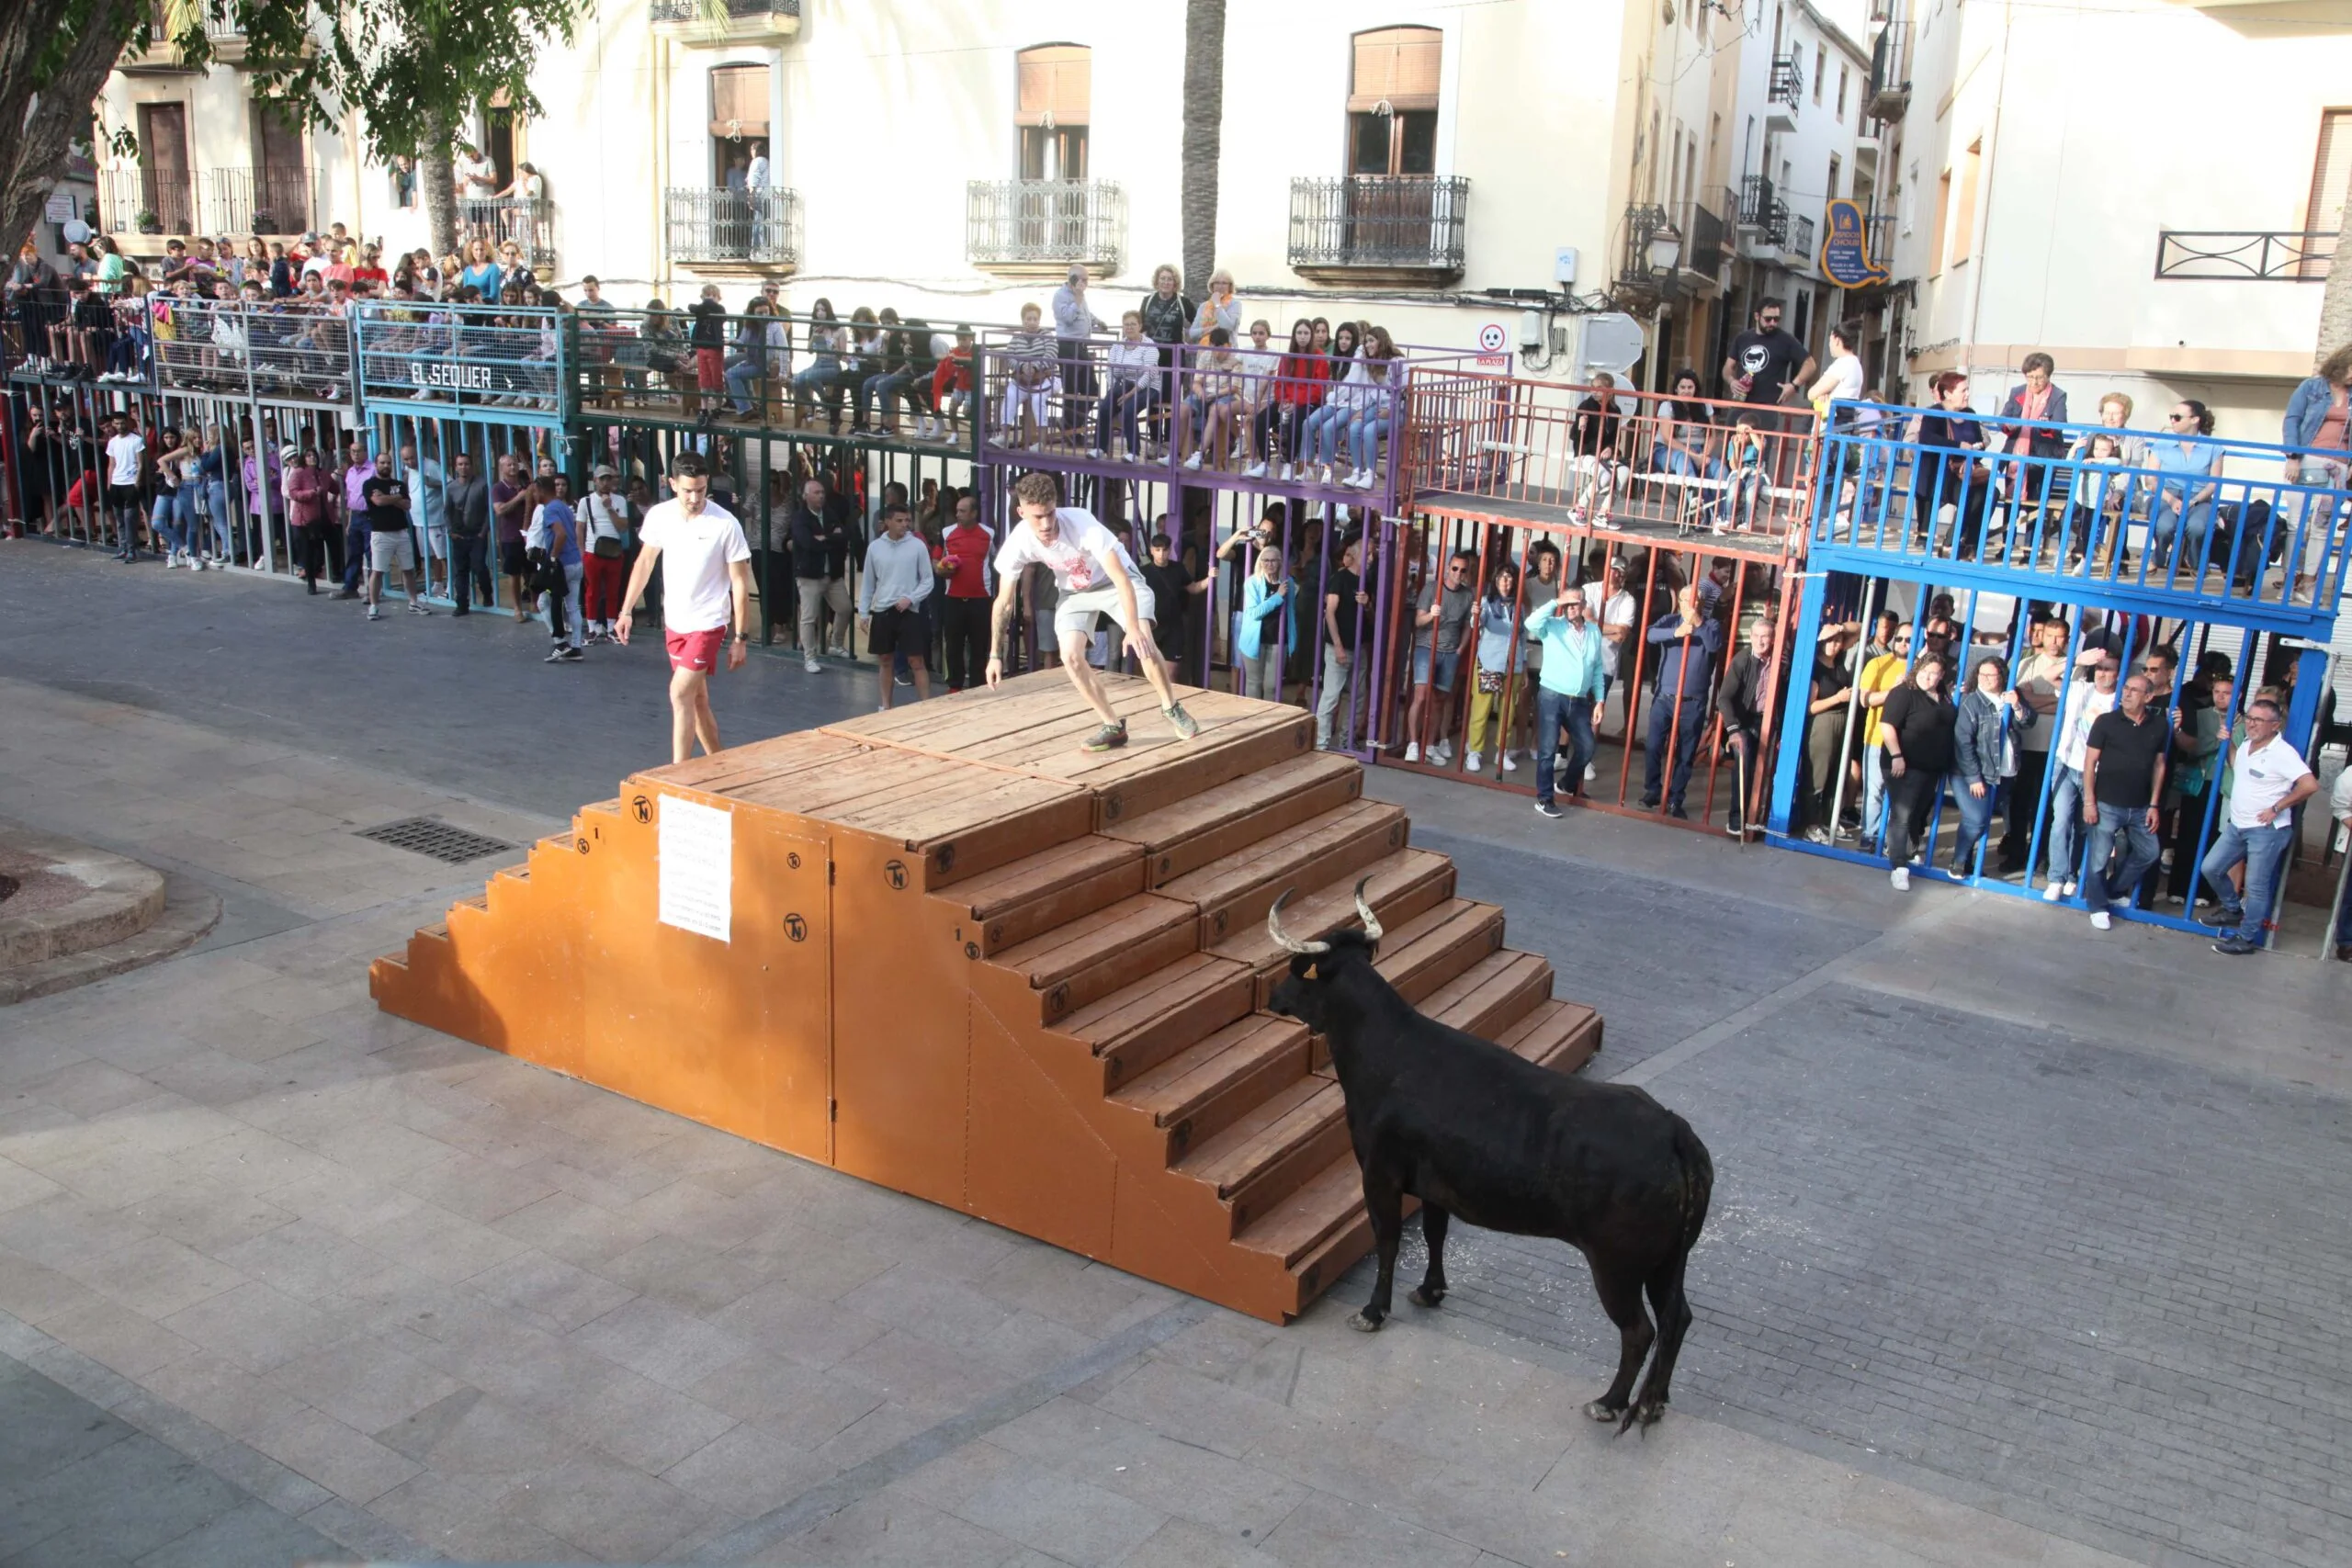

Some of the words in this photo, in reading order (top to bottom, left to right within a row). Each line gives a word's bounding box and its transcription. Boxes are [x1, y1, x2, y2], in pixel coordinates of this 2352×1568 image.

[412, 363, 427, 384] EL
[429, 364, 492, 390] SEQUER
[886, 863, 905, 887] TN
[786, 916, 803, 940] TN
